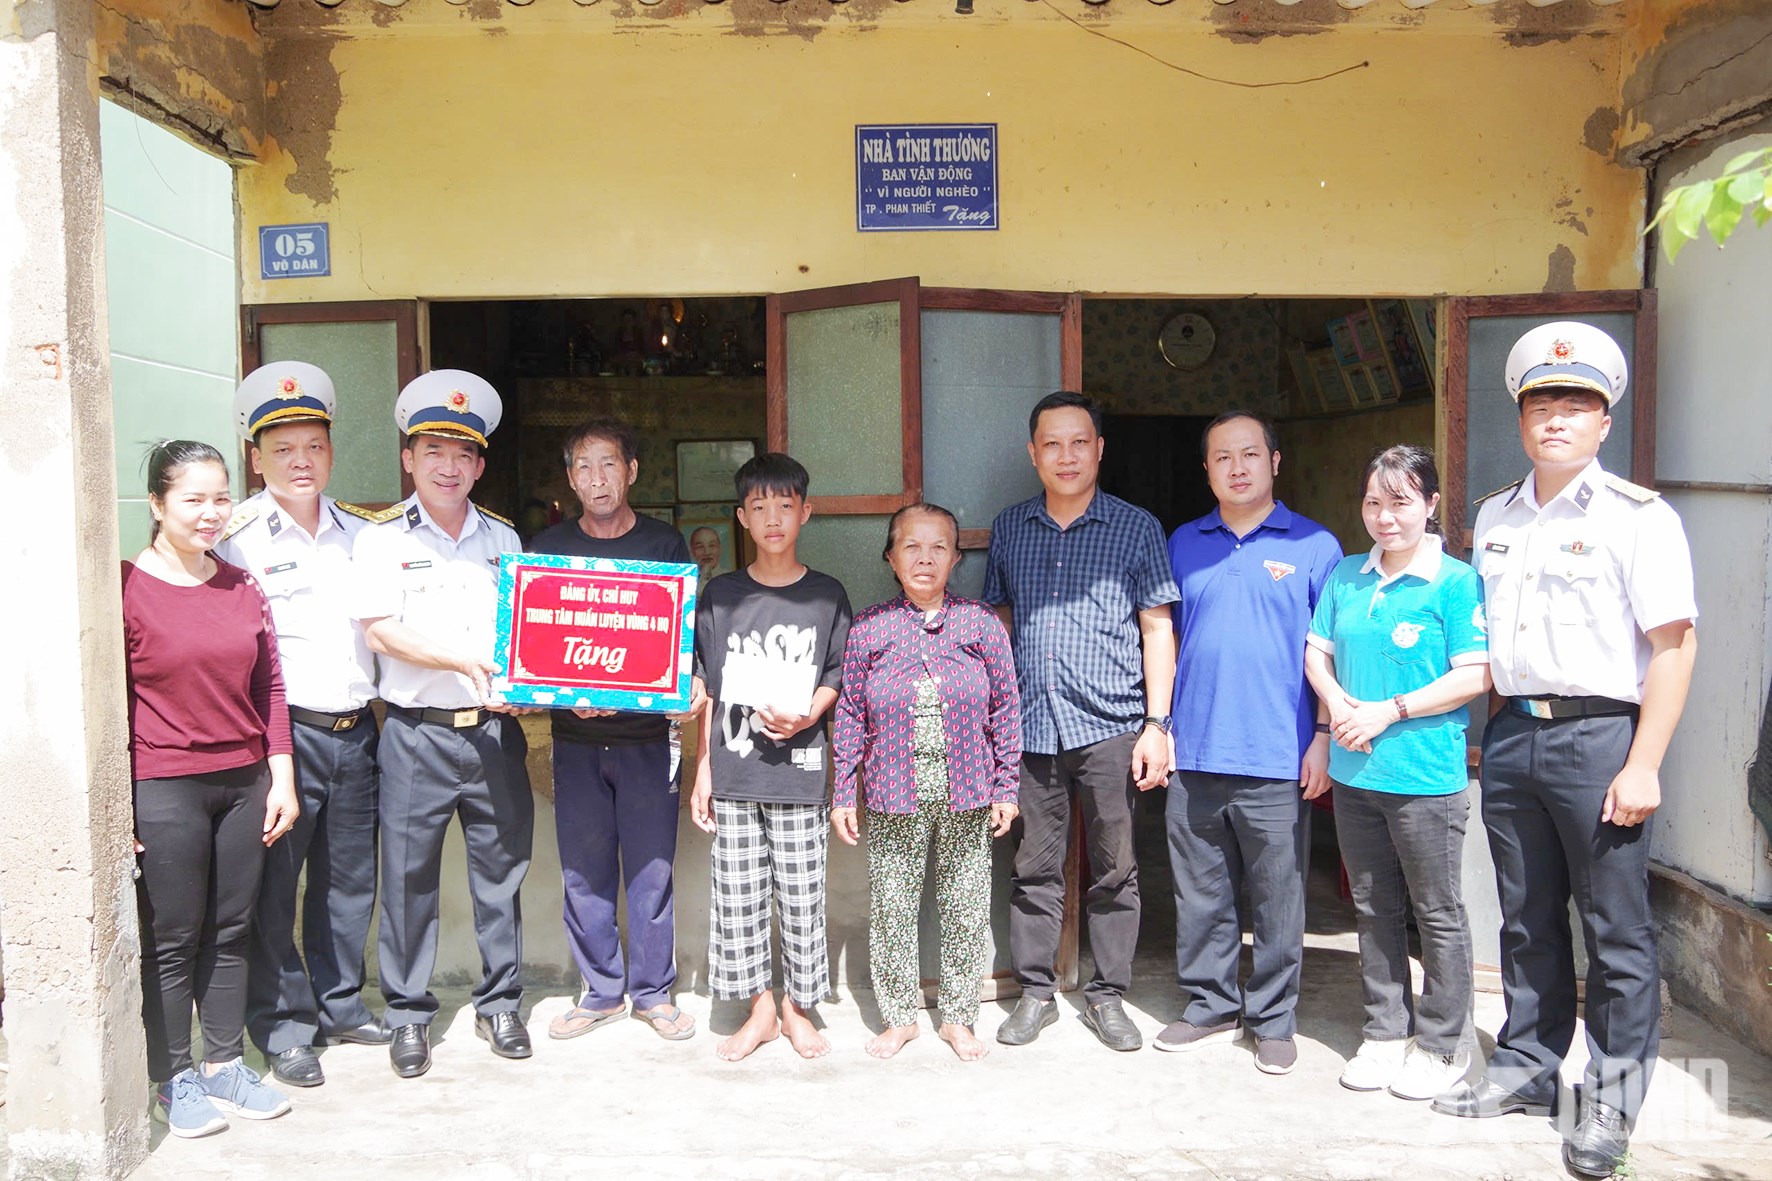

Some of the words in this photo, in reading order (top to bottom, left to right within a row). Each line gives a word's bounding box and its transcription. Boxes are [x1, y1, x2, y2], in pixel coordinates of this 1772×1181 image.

[863, 132, 893, 163] NHÀ
[896, 131, 930, 162] TÌNH
[934, 132, 990, 162] THƯƠNG
[882, 168, 906, 181] BAN
[910, 165, 934, 183] VẬN
[938, 165, 972, 183] ĐỘNG
[894, 185, 931, 197] NGƯỜI
[886, 204, 909, 213] PHAN
[911, 200, 936, 213] THIẾT
[942, 205, 991, 224] Tặng
[275, 232, 315, 257] 05
[602, 585, 619, 604] CHỈ
[620, 590, 639, 605] HUY
[526, 607, 554, 624] TRUNG
[555, 607, 573, 625] TÂM
[574, 607, 598, 627] HUẤN
[599, 611, 625, 631] LUYỆN
[626, 612, 649, 630] VÙNG
[650, 616, 656, 631] 4
[657, 617, 669, 634] HQ
[564, 636, 627, 673] Tặng
